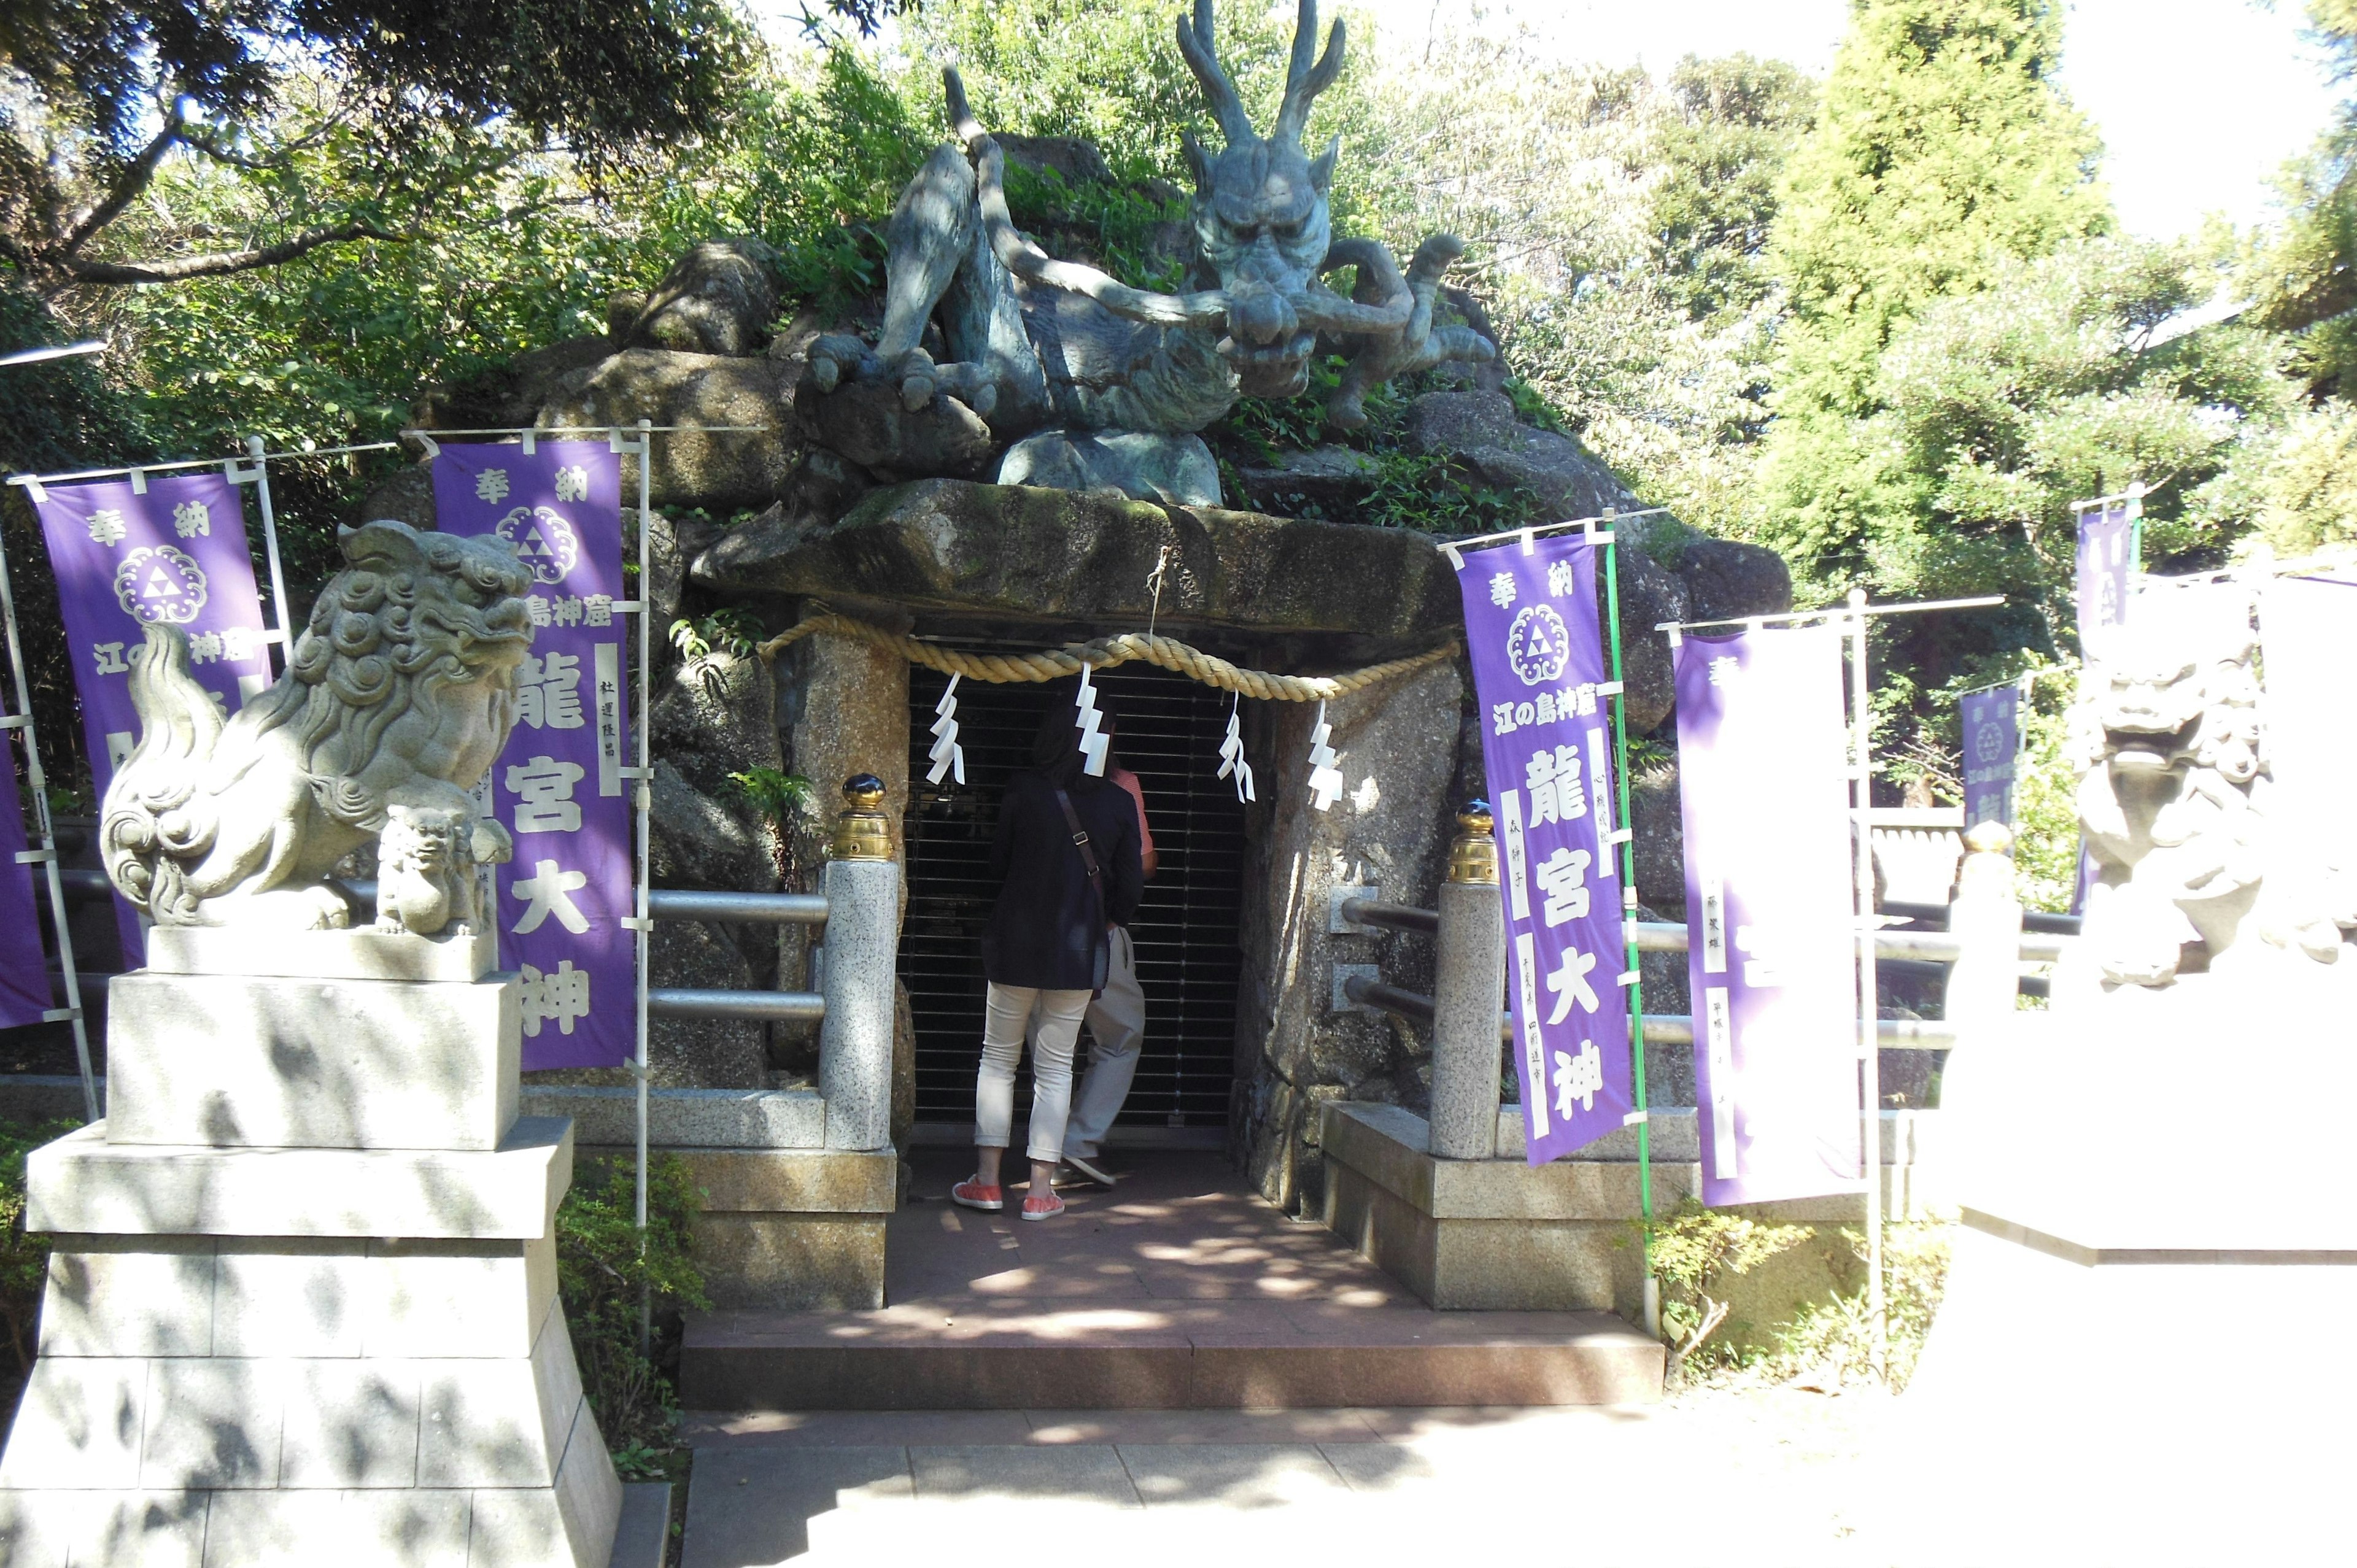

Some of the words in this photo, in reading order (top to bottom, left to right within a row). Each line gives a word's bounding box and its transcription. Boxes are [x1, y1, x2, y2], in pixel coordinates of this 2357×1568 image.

[475, 468, 509, 504] 奉
[555, 465, 588, 502] 納
[87, 509, 126, 546] 奉
[173, 501, 211, 538] 納
[1489, 572, 1516, 609] 奉
[1547, 560, 1573, 597] 納
[1493, 682, 1597, 736] 江の島神窟
[505, 652, 589, 1036] 龍宮大神
[1526, 744, 1603, 1121] 龍宮大神
